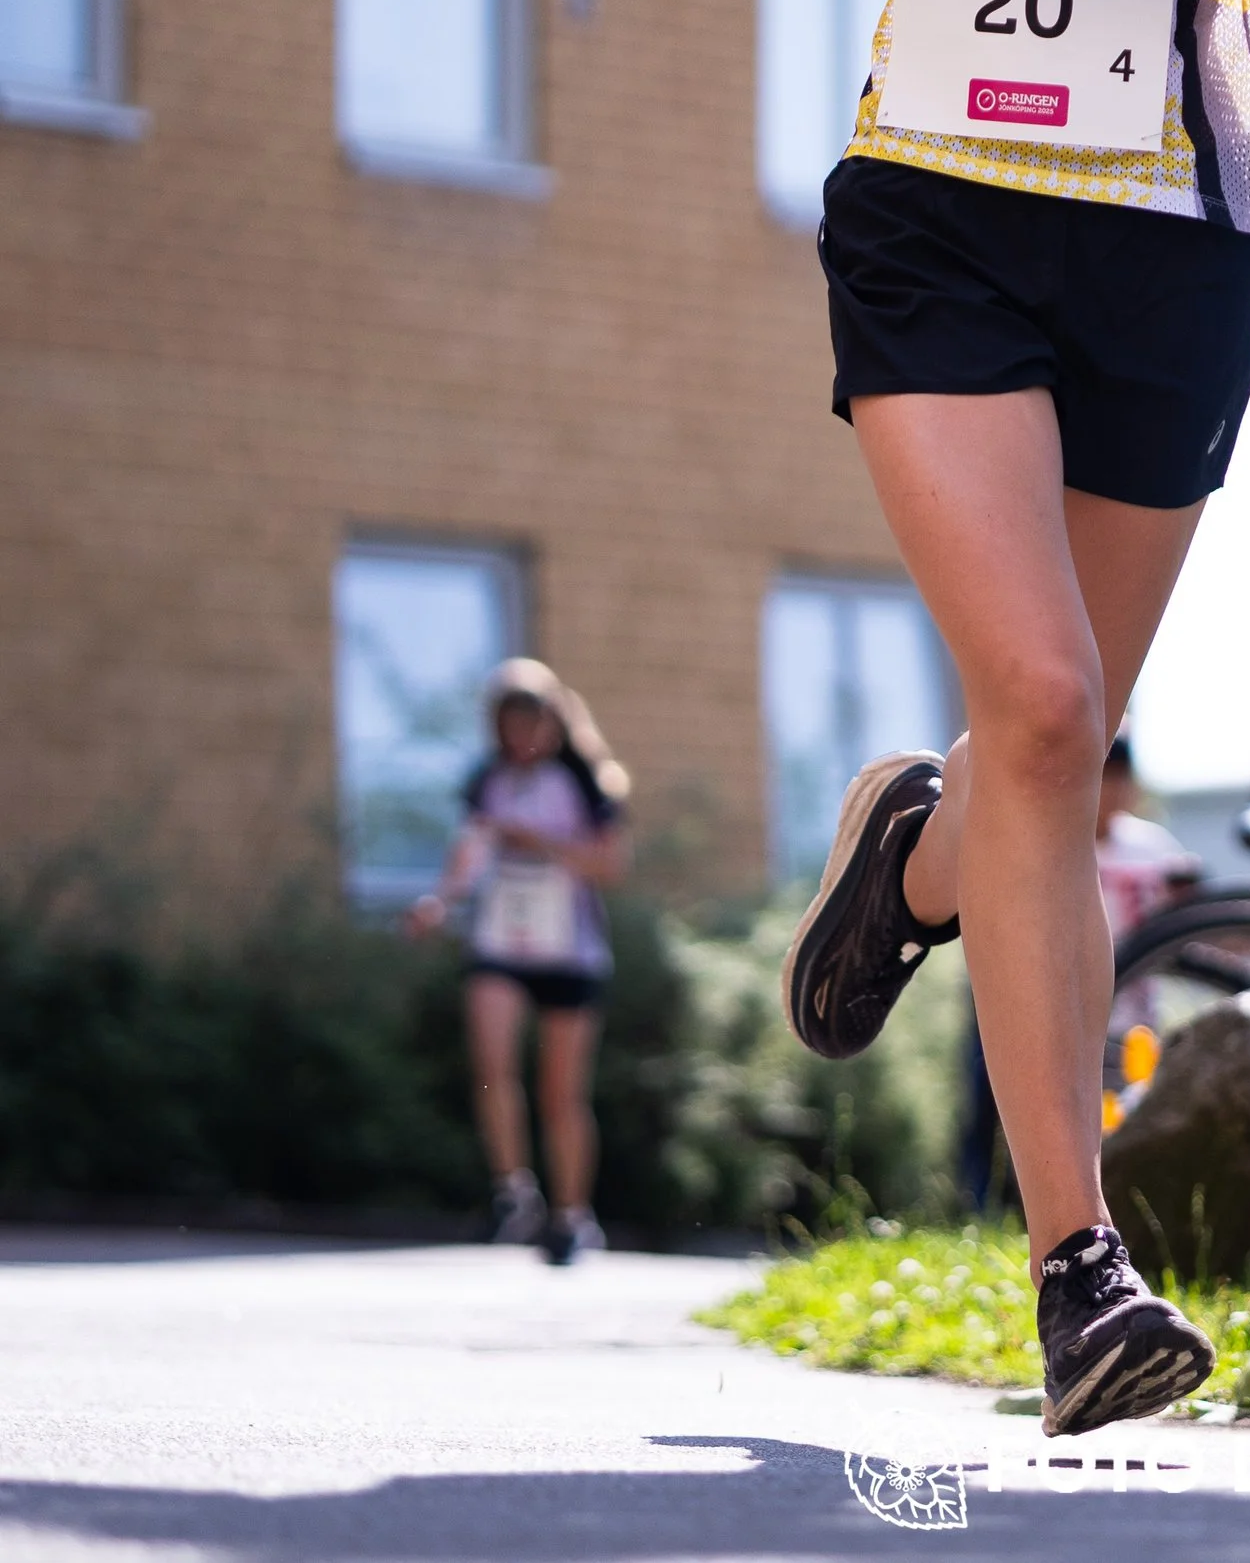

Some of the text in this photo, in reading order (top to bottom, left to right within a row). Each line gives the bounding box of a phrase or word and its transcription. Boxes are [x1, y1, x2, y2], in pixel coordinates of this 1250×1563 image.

[1109, 49, 1135, 82] 4
[998, 92, 1060, 107] O-RINGEN
[998, 103, 1037, 114] JÖNKÖPING
